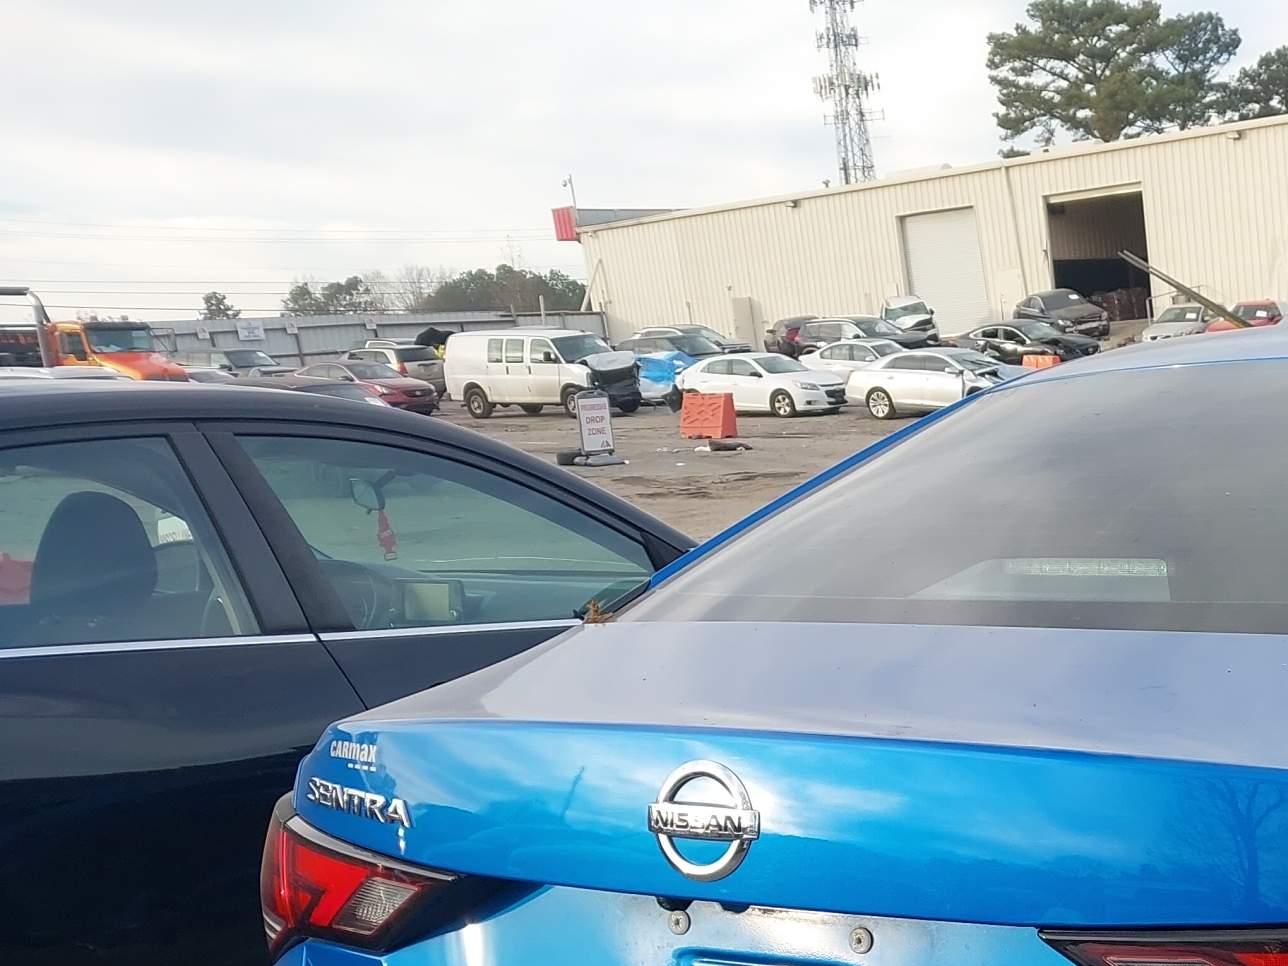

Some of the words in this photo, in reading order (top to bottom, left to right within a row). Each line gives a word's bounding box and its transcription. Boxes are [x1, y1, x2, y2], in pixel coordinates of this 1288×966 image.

[585, 416, 605, 425] DROP
[587, 427, 607, 436] ZONE
[306, 776, 412, 829] SENTRA
[653, 809, 743, 834] NISSAN
